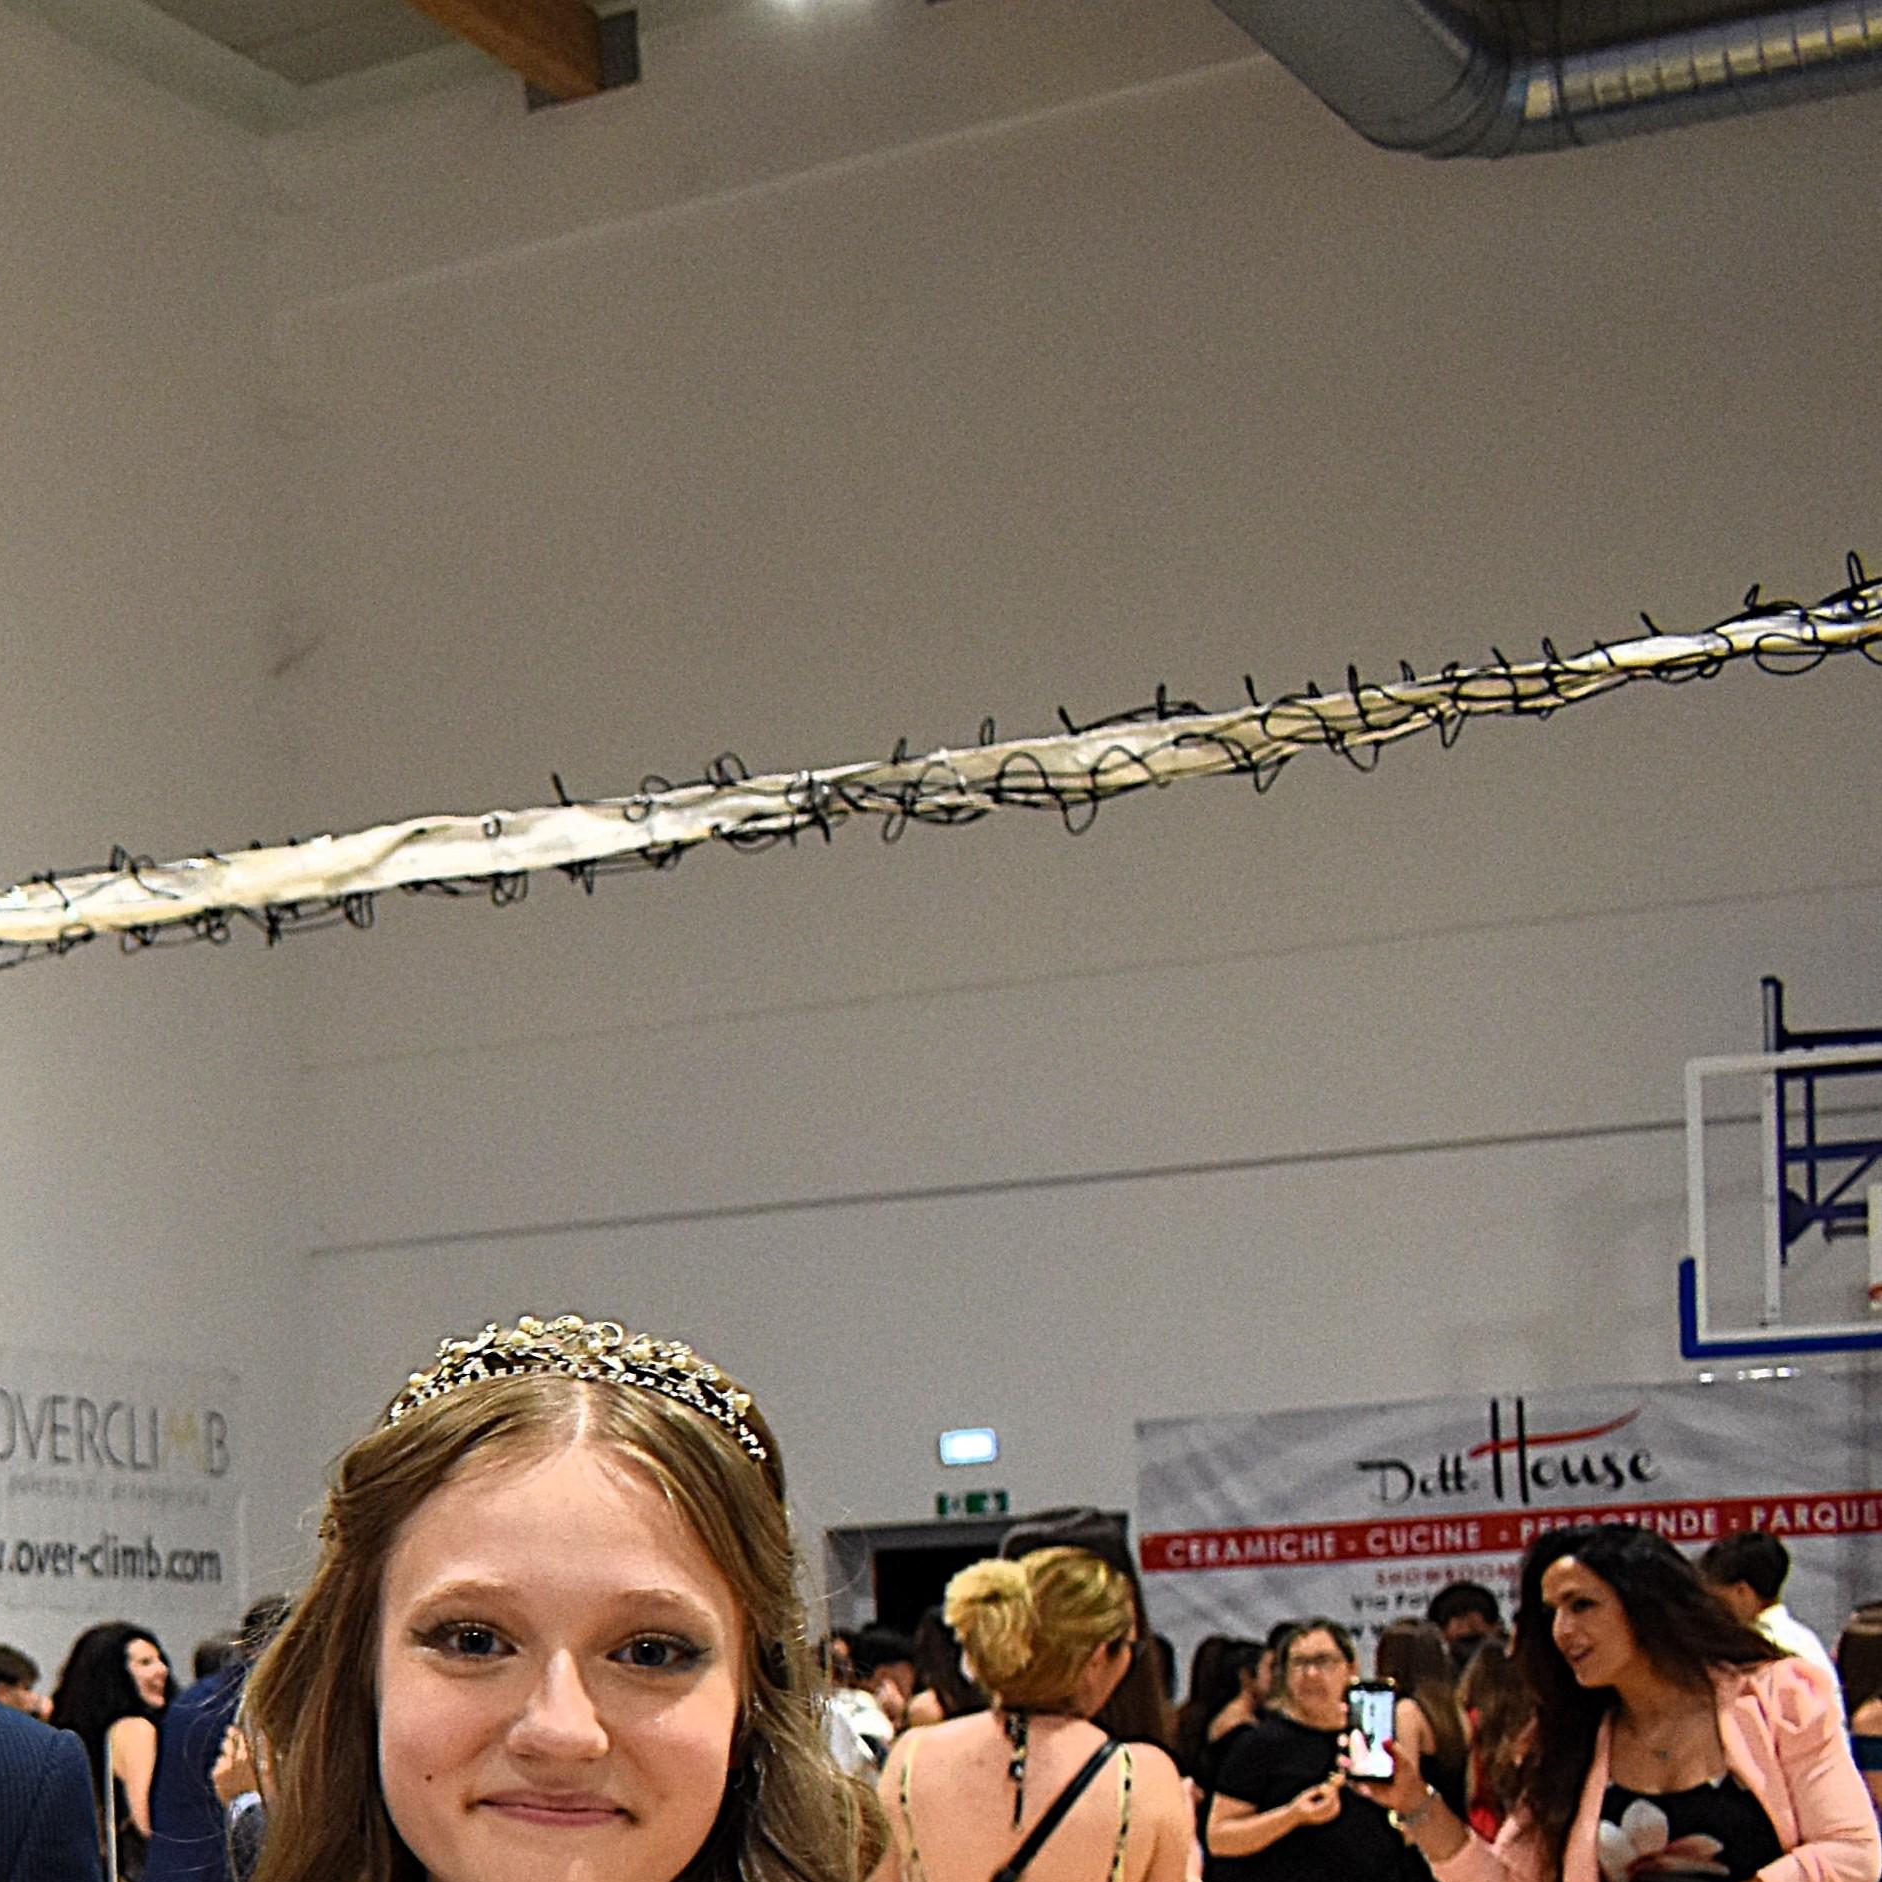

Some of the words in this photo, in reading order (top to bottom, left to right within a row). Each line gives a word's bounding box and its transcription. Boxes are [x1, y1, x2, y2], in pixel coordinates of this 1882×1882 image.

[1470, 1396, 1661, 1504] House
[1166, 1530, 1337, 1568] CERAMICHE
[1366, 1521, 1481, 1556] CUCINE
[1750, 1500, 1882, 1535] PARQUE
